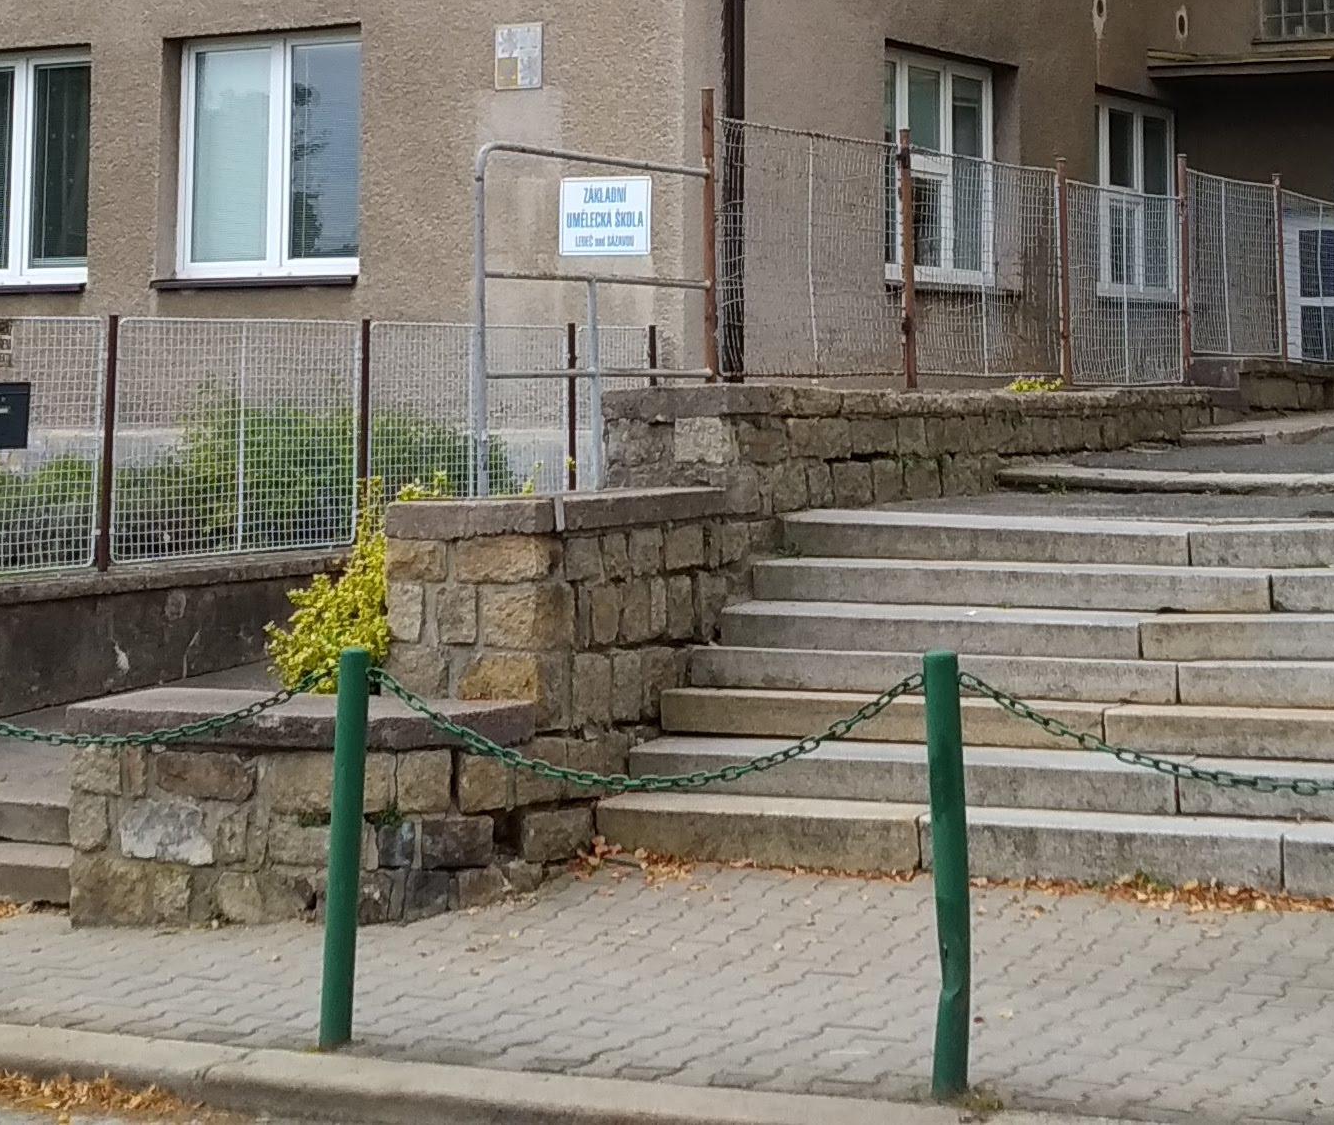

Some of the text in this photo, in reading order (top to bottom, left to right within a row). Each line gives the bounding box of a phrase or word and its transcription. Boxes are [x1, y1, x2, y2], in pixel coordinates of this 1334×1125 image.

[583, 183, 627, 204] ZÁKLADNÍ
[566, 208, 644, 229] UMĚLECKÁ ŠKOLA
